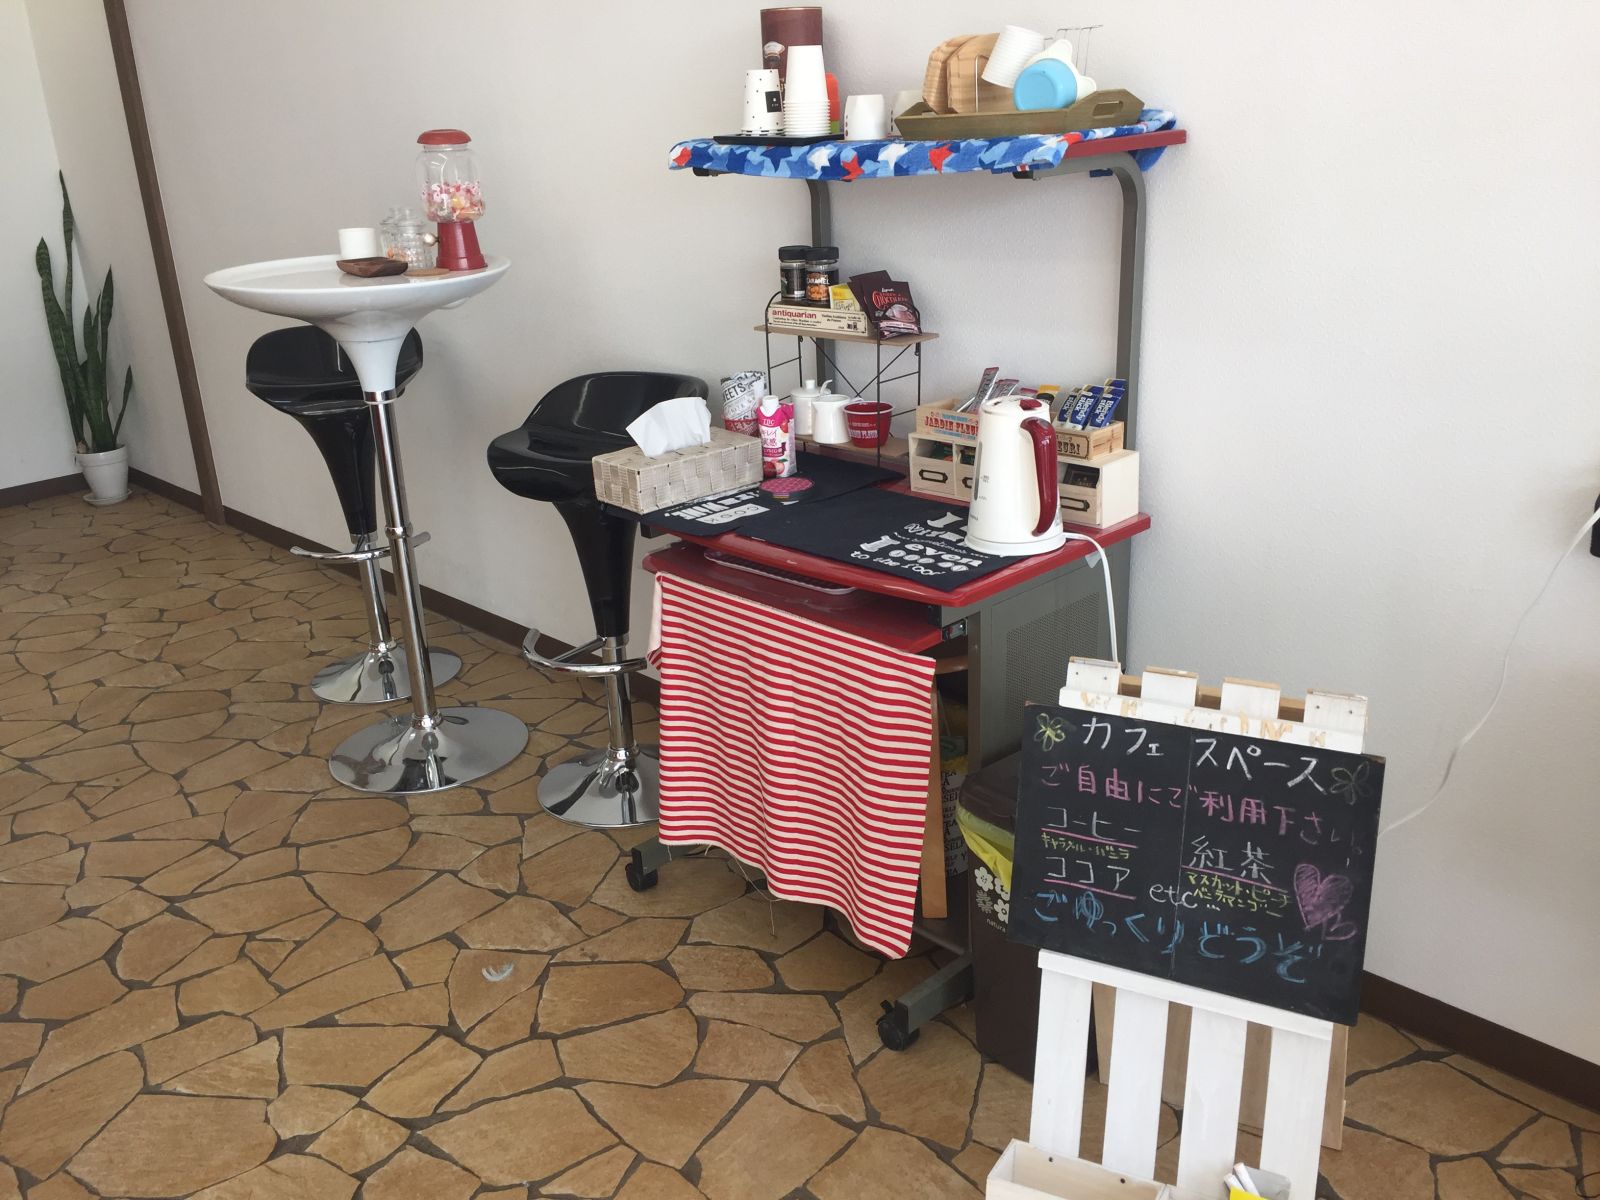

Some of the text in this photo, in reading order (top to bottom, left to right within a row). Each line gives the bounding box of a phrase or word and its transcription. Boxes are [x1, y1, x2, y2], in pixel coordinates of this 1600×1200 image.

[772, 309, 817, 320] antiquarian
[954, 421, 979, 437] FLEU
[1057, 439, 1081, 455] EURI
[850, 550, 870, 560] to
[904, 543, 983, 567] even
[1082, 716, 1165, 757] カフェ
[1195, 736, 1328, 796] スペース
[1046, 805, 1143, 842] コーヒー
[1188, 834, 1276, 885] 紅茶
[1045, 855, 1131, 892] ココア
